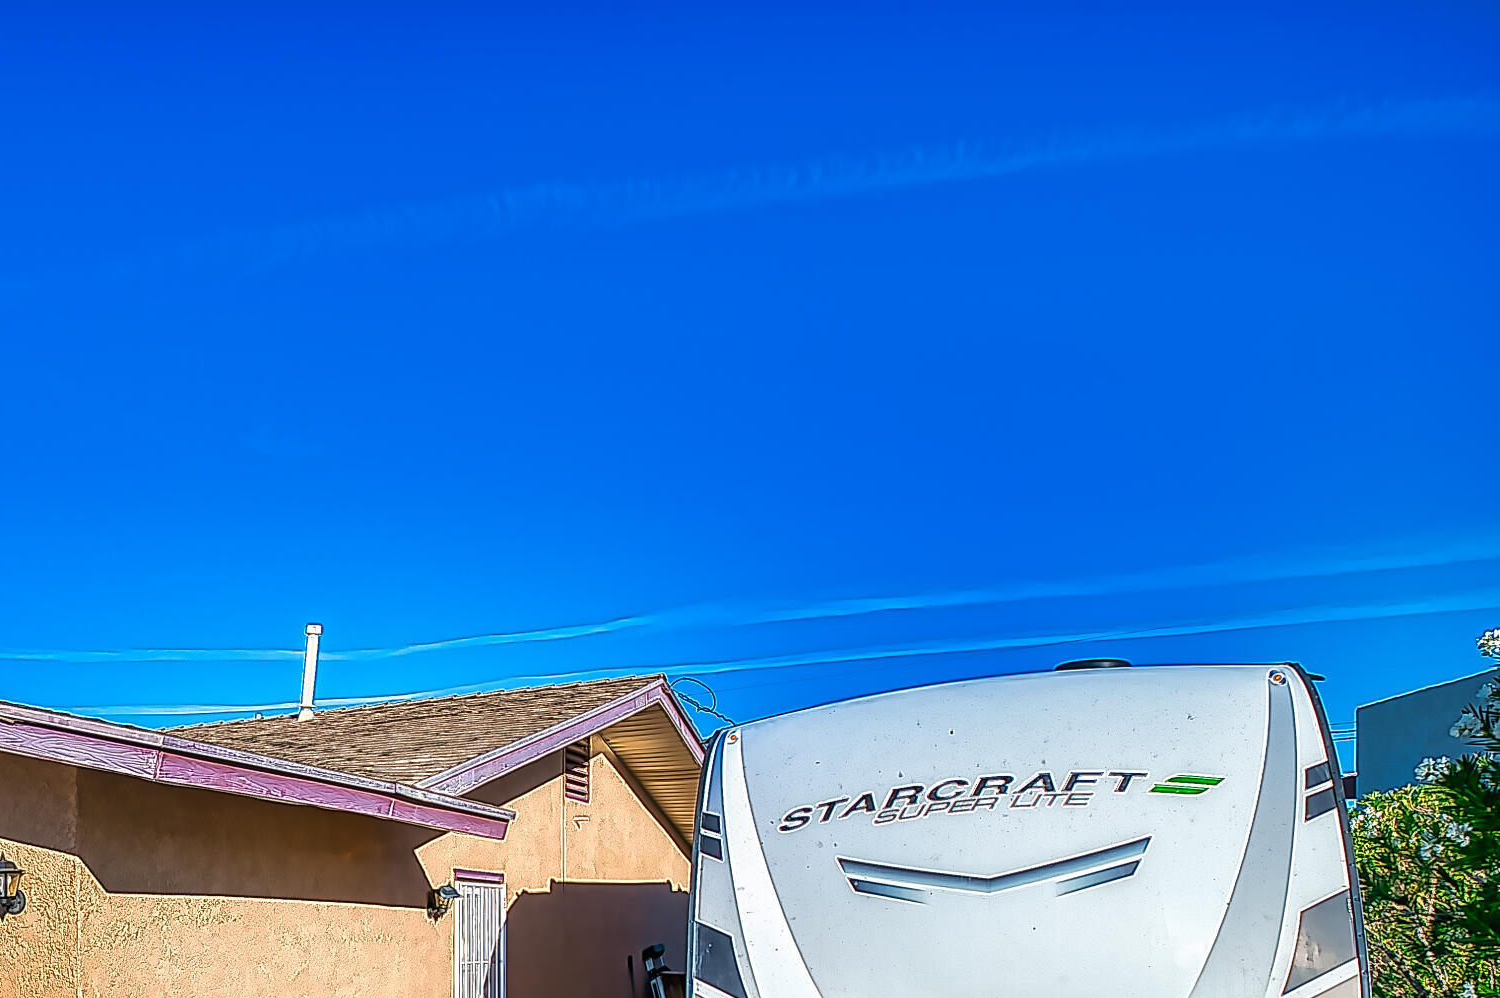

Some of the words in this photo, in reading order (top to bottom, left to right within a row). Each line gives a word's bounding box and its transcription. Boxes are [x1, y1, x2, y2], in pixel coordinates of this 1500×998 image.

[779, 771, 1149, 831] STARCRAFT
[873, 796, 999, 824] SUPER
[1009, 792, 1094, 808] LITE
